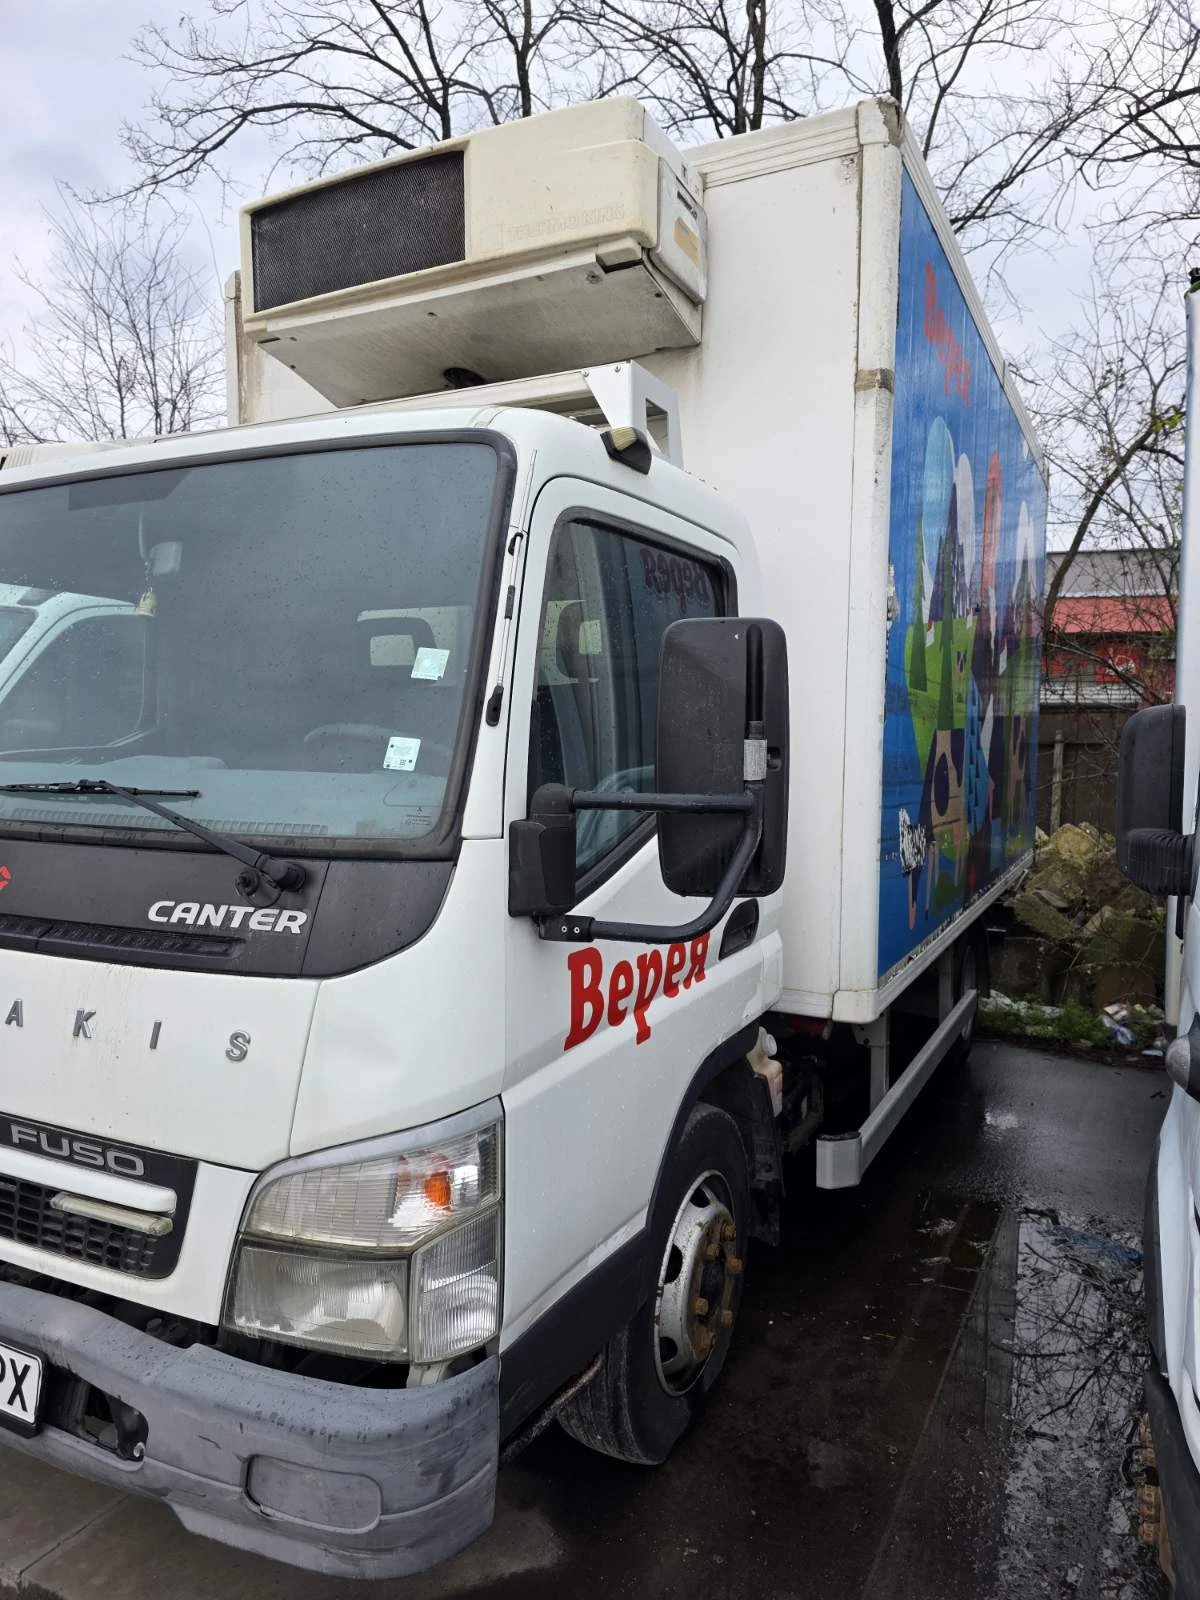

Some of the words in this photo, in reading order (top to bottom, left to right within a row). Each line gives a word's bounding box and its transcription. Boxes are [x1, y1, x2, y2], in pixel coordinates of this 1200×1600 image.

[147, 900, 308, 934] CANTER
[563, 930, 711, 1052] Верея
[10, 1124, 146, 1177] FUSO
